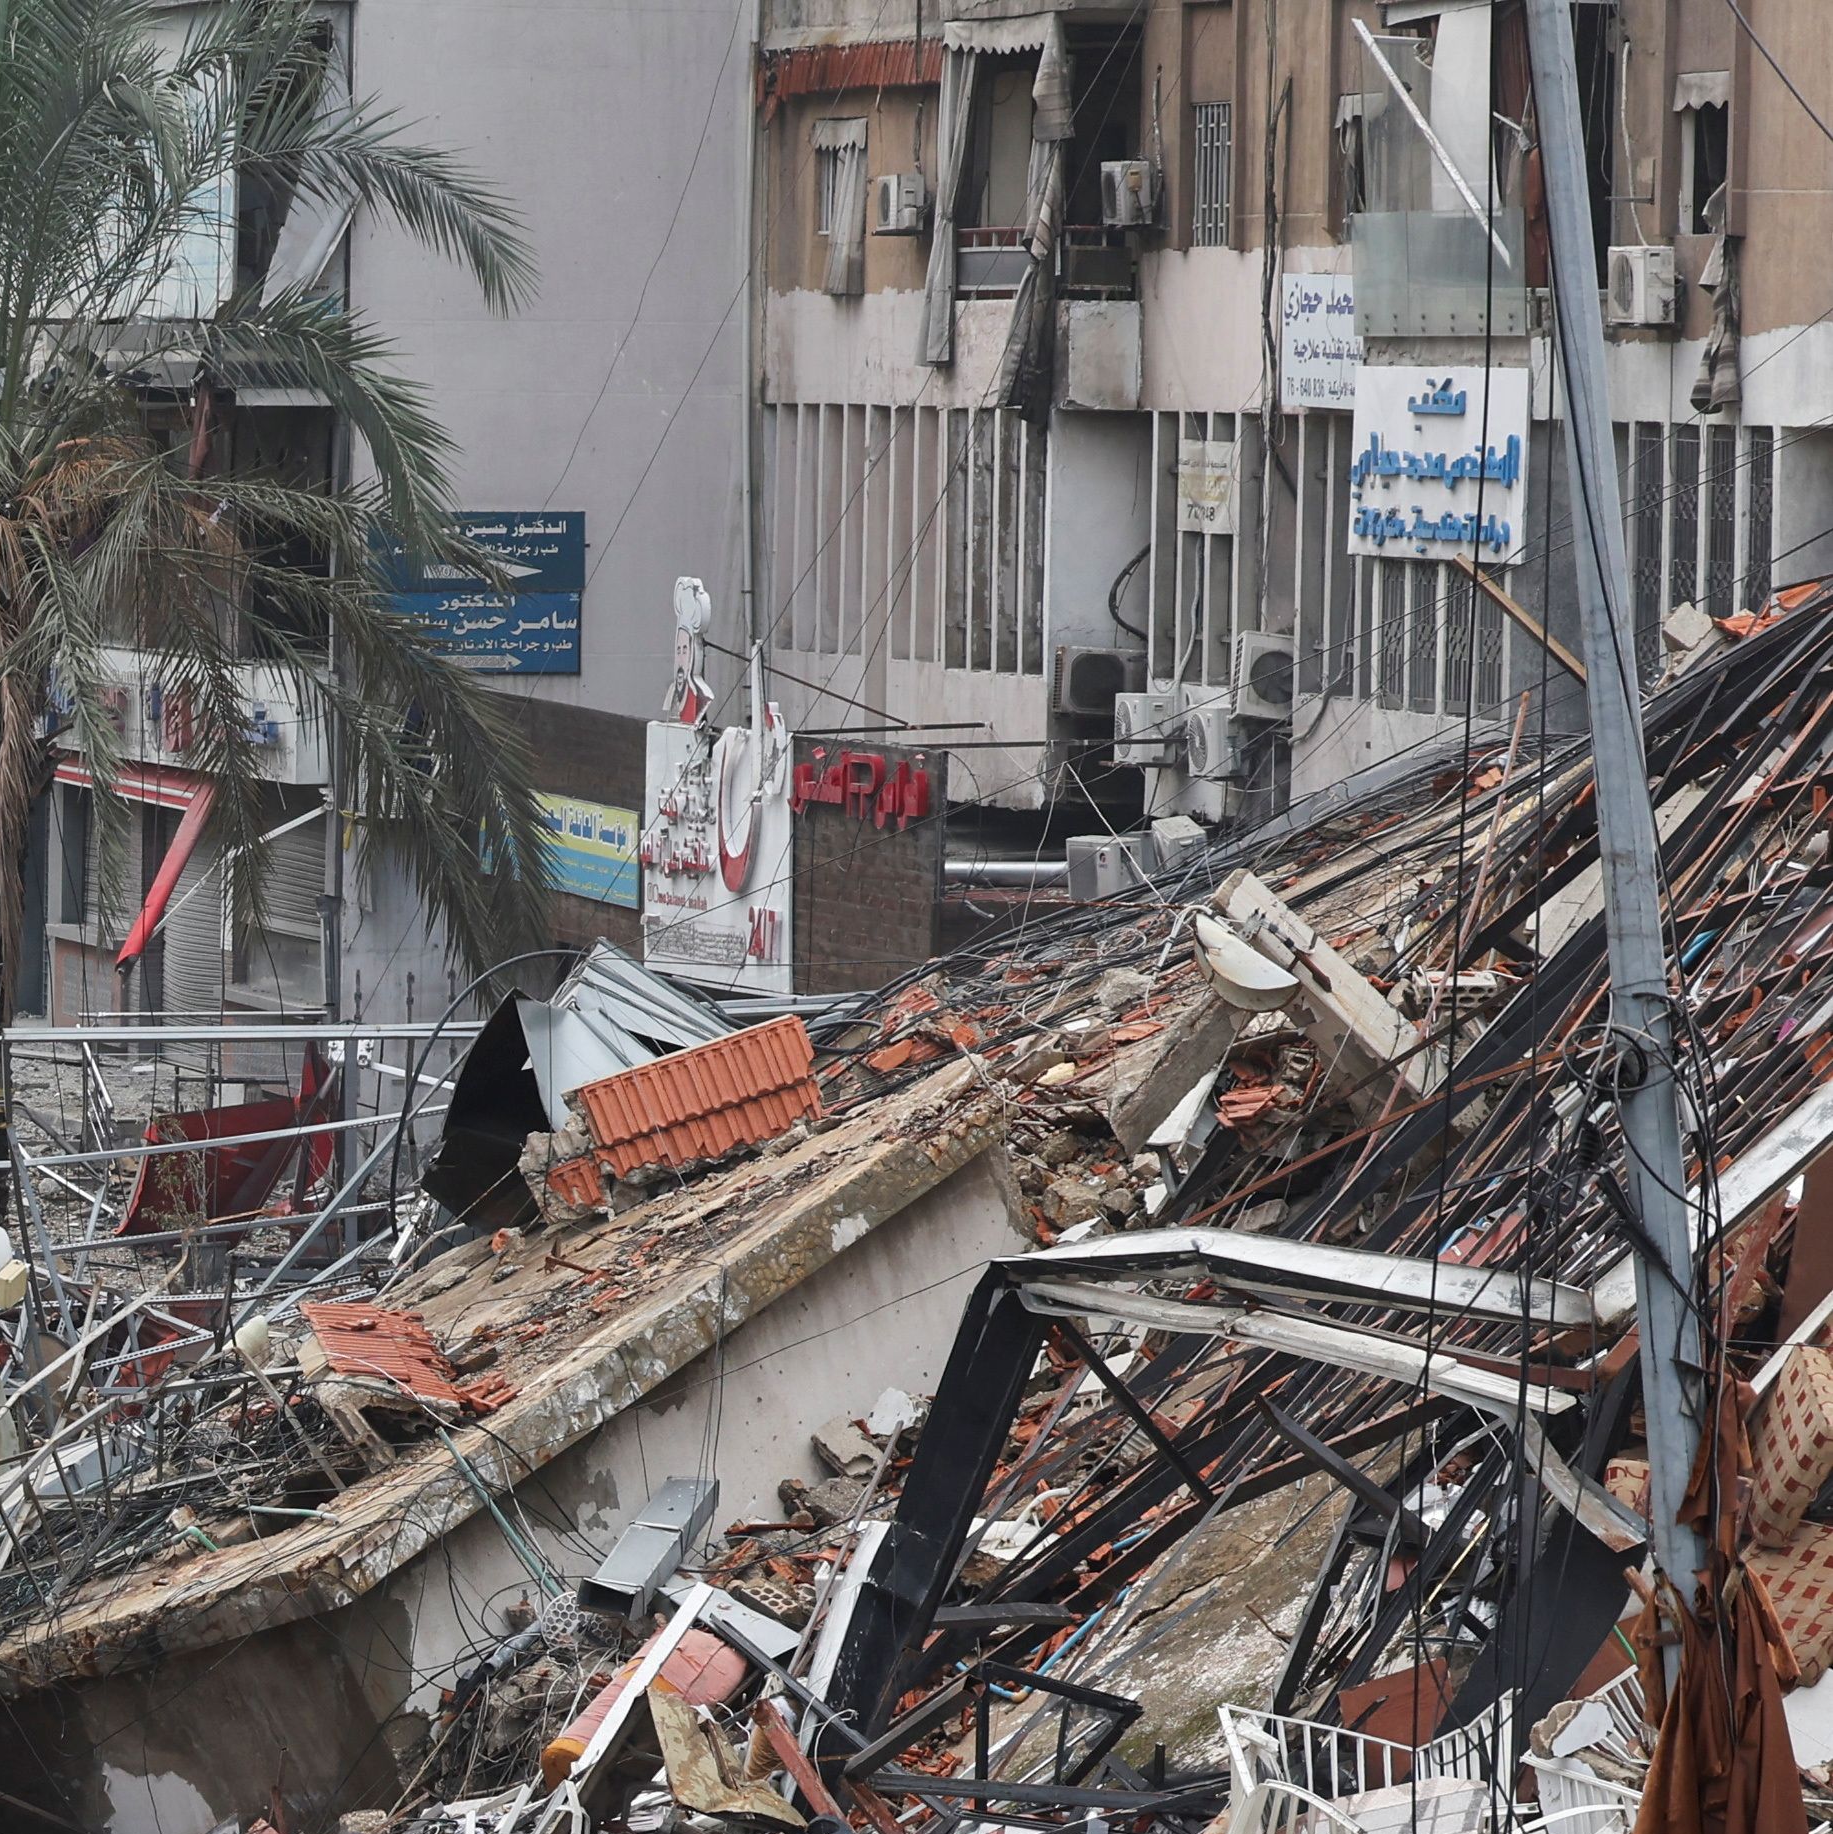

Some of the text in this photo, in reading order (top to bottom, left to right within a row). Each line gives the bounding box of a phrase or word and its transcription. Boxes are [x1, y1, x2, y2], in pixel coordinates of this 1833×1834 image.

[1326, 289, 1354, 317] حمد
[1407, 377, 1467, 432] مكتب
[511, 519, 567, 537] الدكتور
[509, 610, 578, 636] سامر
[501, 638, 540, 652] جراحة
